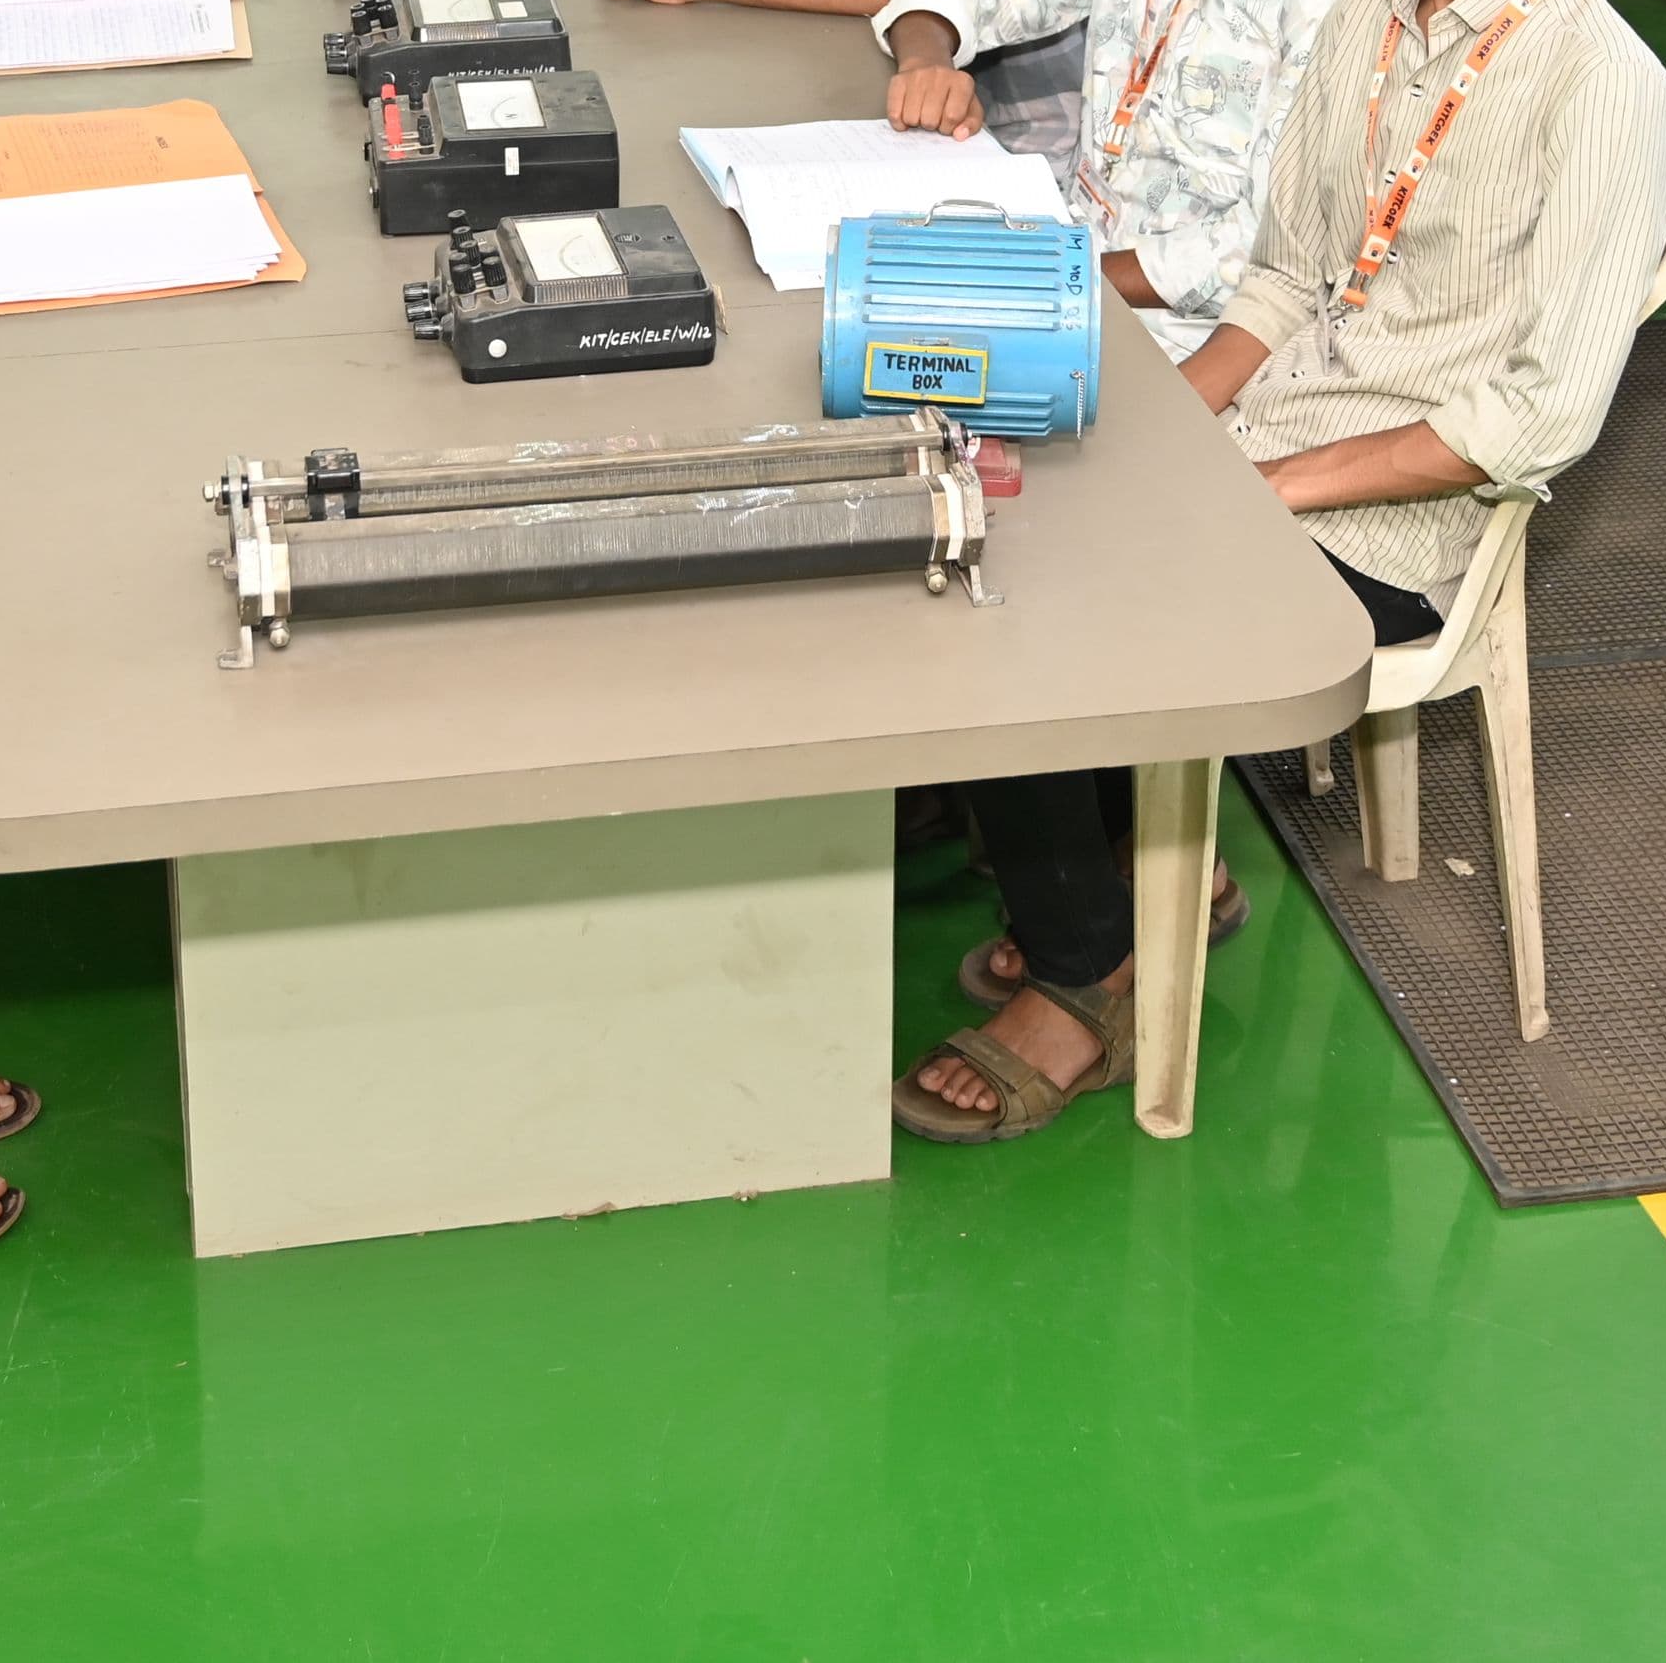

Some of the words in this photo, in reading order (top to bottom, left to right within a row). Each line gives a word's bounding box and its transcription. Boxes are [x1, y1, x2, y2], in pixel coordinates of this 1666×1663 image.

[579, 322, 712, 350] KIT/CEK/ELE/W/12
[883, 352, 977, 374] TERMINAL
[912, 374, 943, 390] BOX
